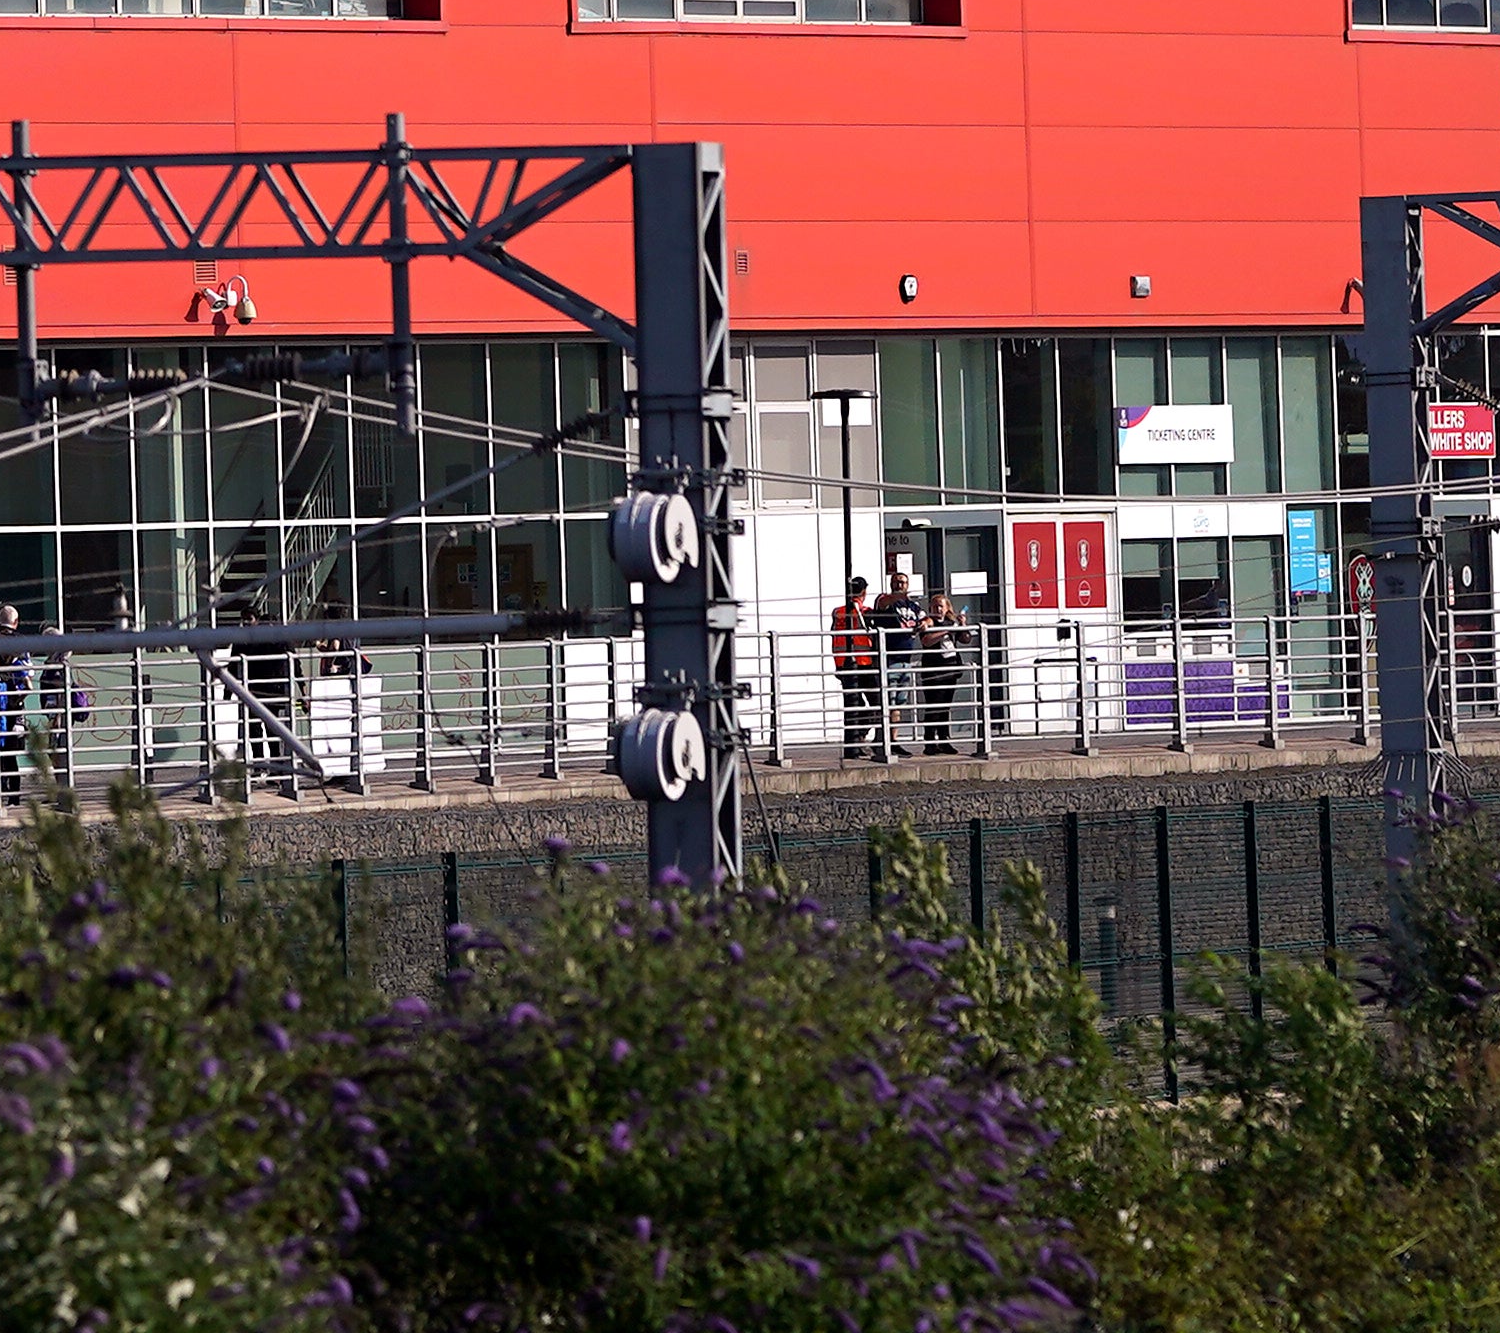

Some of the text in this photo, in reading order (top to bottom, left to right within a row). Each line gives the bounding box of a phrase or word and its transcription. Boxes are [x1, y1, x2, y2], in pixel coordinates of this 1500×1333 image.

[1429, 410, 1466, 429] ILLERS
[1147, 428, 1216, 442] TICKETING CENTRE
[1430, 431, 1494, 451] WHITE SHOP
